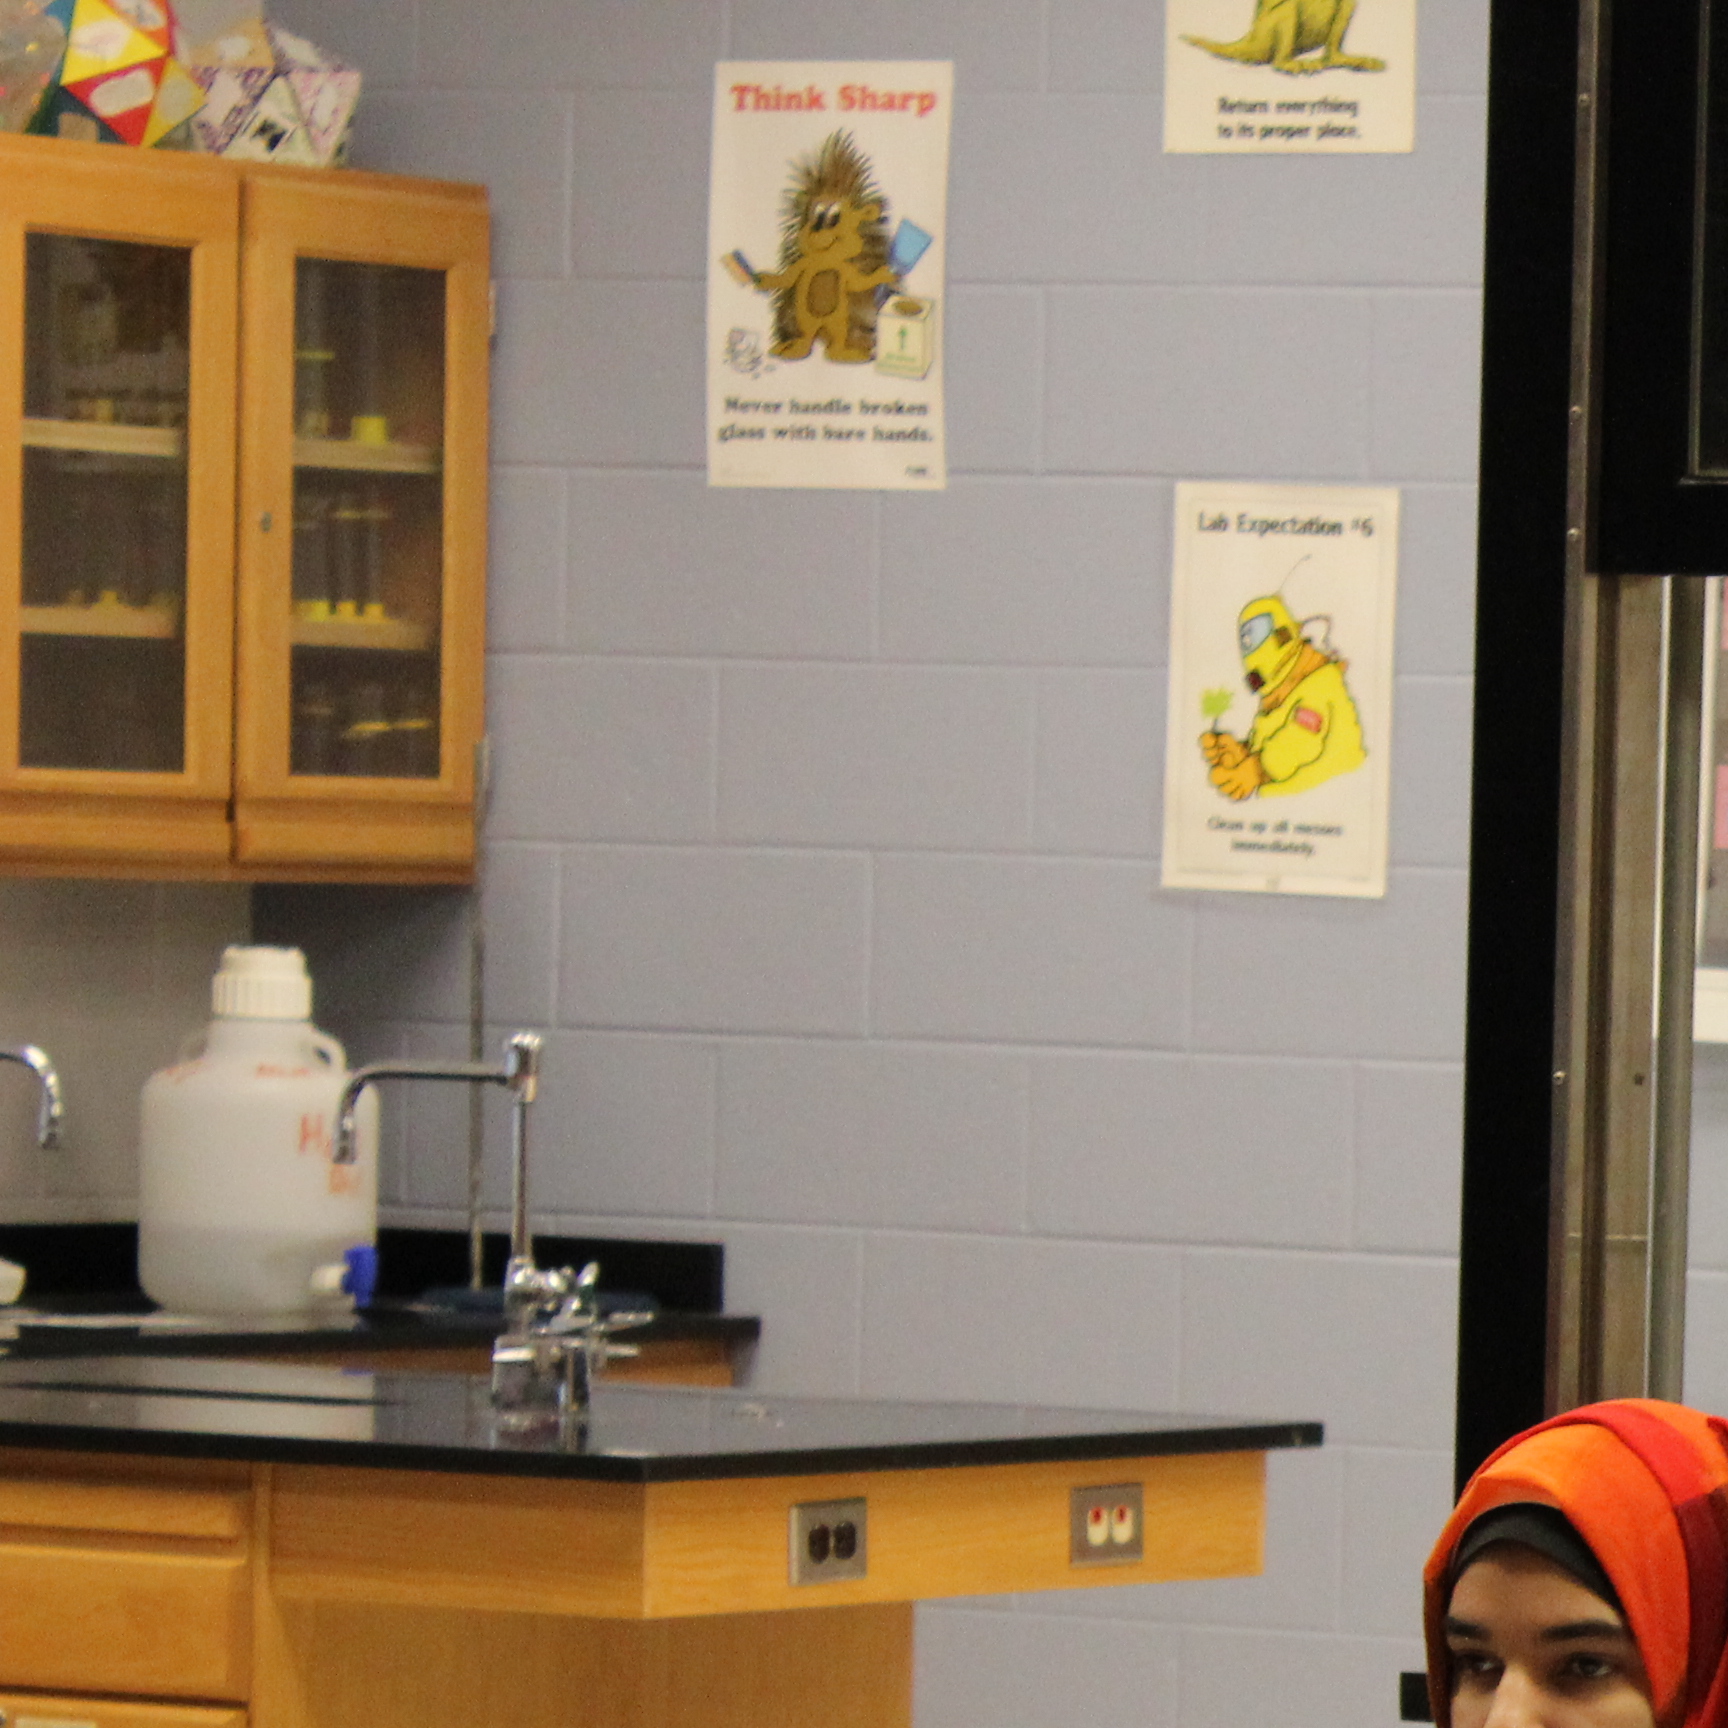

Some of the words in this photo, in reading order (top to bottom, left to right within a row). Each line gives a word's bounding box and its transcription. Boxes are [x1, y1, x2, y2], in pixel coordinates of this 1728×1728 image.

[730, 84, 826, 112] Think
[839, 84, 938, 118] Sharp
[1218, 95, 1268, 114] Return
[1275, 96, 1359, 118] everything
[1259, 126, 1312, 140] proper
[724, 396, 783, 413] Never
[789, 398, 852, 415] handle
[859, 398, 928, 416] broken
[717, 423, 766, 443] glass
[773, 424, 817, 441] with
[823, 424, 866, 441] bare
[1199, 511, 1229, 532] Lab
[1236, 512, 1343, 538] Expectation
